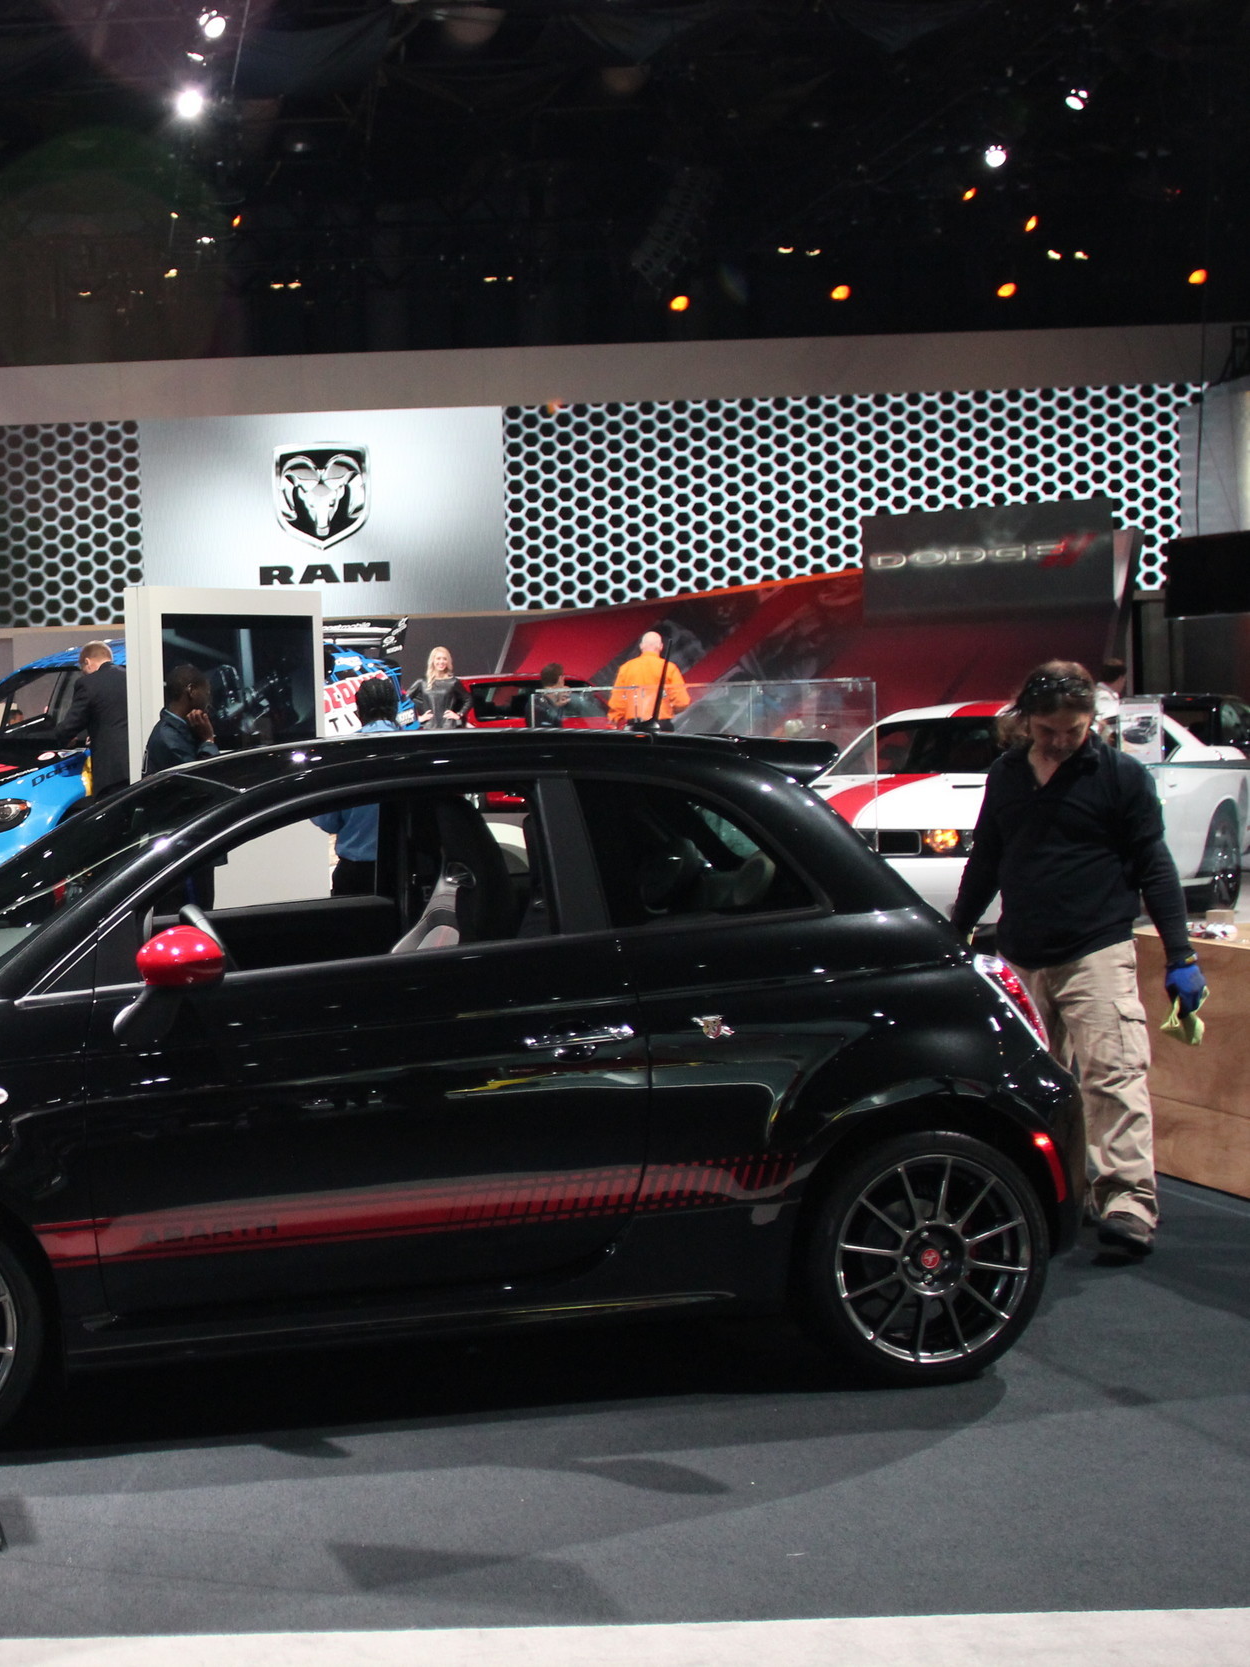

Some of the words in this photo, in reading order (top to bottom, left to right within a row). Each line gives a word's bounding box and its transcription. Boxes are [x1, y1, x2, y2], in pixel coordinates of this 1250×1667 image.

[869, 541, 1065, 570] DODGE
[259, 561, 391, 586] RAM
[140, 1218, 278, 1244] ABARTH
